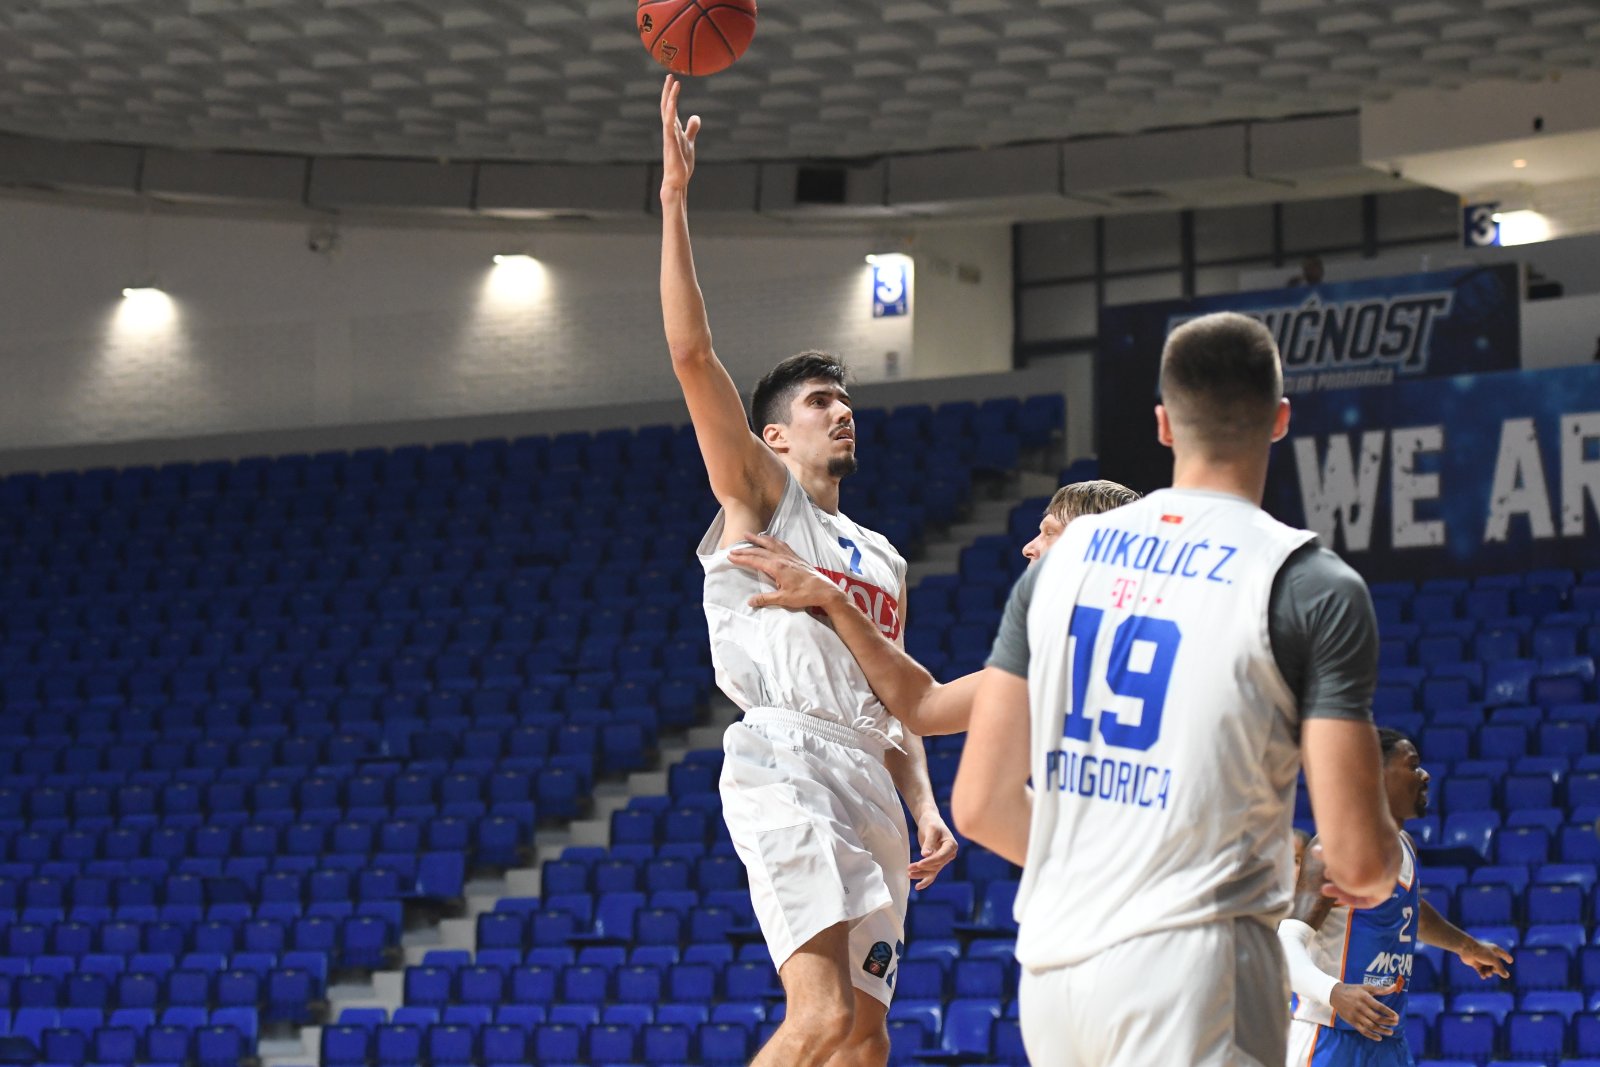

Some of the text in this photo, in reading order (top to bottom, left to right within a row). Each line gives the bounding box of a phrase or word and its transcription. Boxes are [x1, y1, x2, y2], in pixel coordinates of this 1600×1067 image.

[1471, 208, 1497, 246] 3
[876, 256, 904, 303] 3
[1246, 291, 1453, 371] UĆNOST
[1293, 426, 1446, 552] WE
[838, 535, 864, 575] 7
[1083, 527, 1209, 577] NIKOLIĆ
[1062, 604, 1182, 752] 19
[1399, 906, 1413, 943] 2
